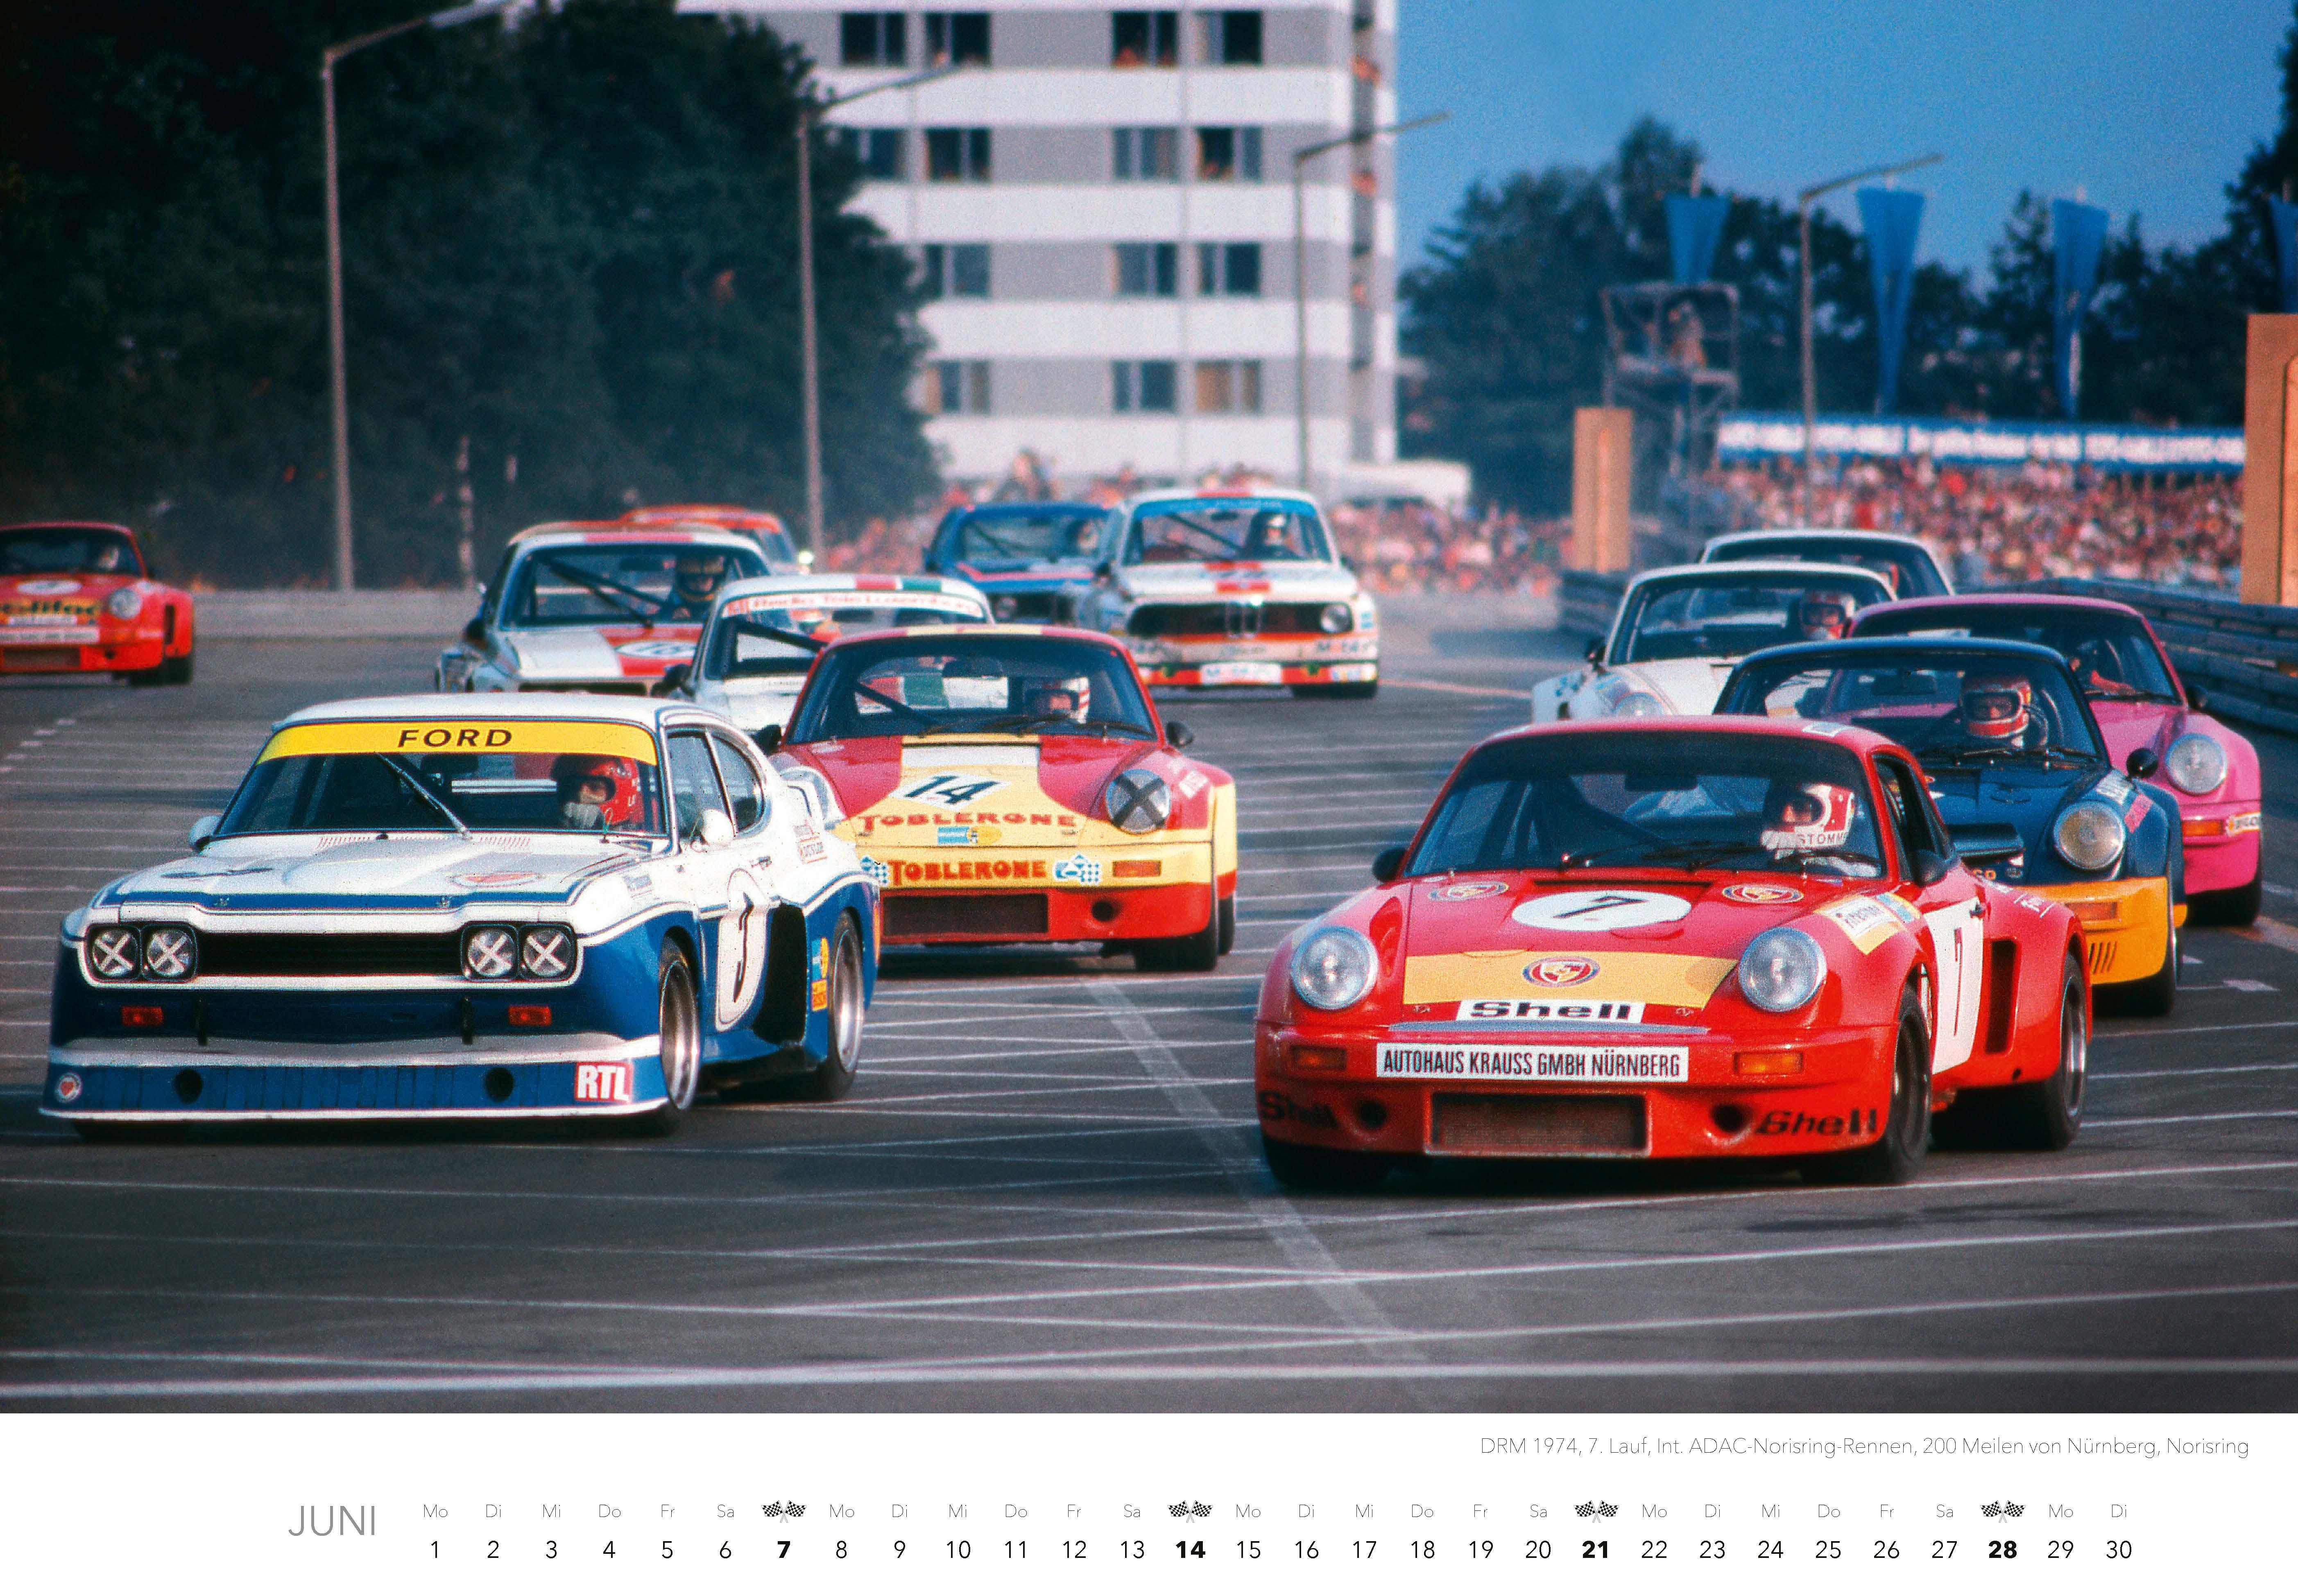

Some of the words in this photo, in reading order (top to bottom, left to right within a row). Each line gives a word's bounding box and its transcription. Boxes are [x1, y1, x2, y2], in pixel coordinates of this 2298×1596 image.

[397, 728, 512, 748] FORD
[904, 775, 1001, 805] 14
[858, 812, 1077, 832] TOBLERONE
[887, 859, 1046, 886] TOBLERONE
[1553, 895, 1650, 918] 7
[733, 891, 754, 1003] 3
[1469, 1001, 1632, 1019] Shell
[1383, 1049, 1464, 1074] AUTOHAUS
[1469, 1051, 1533, 1075] KRAUSS
[1537, 1053, 1585, 1076] GMBH
[1591, 1049, 1680, 1077] NÜRNBERG
[577, 1065, 629, 1101] RTL
